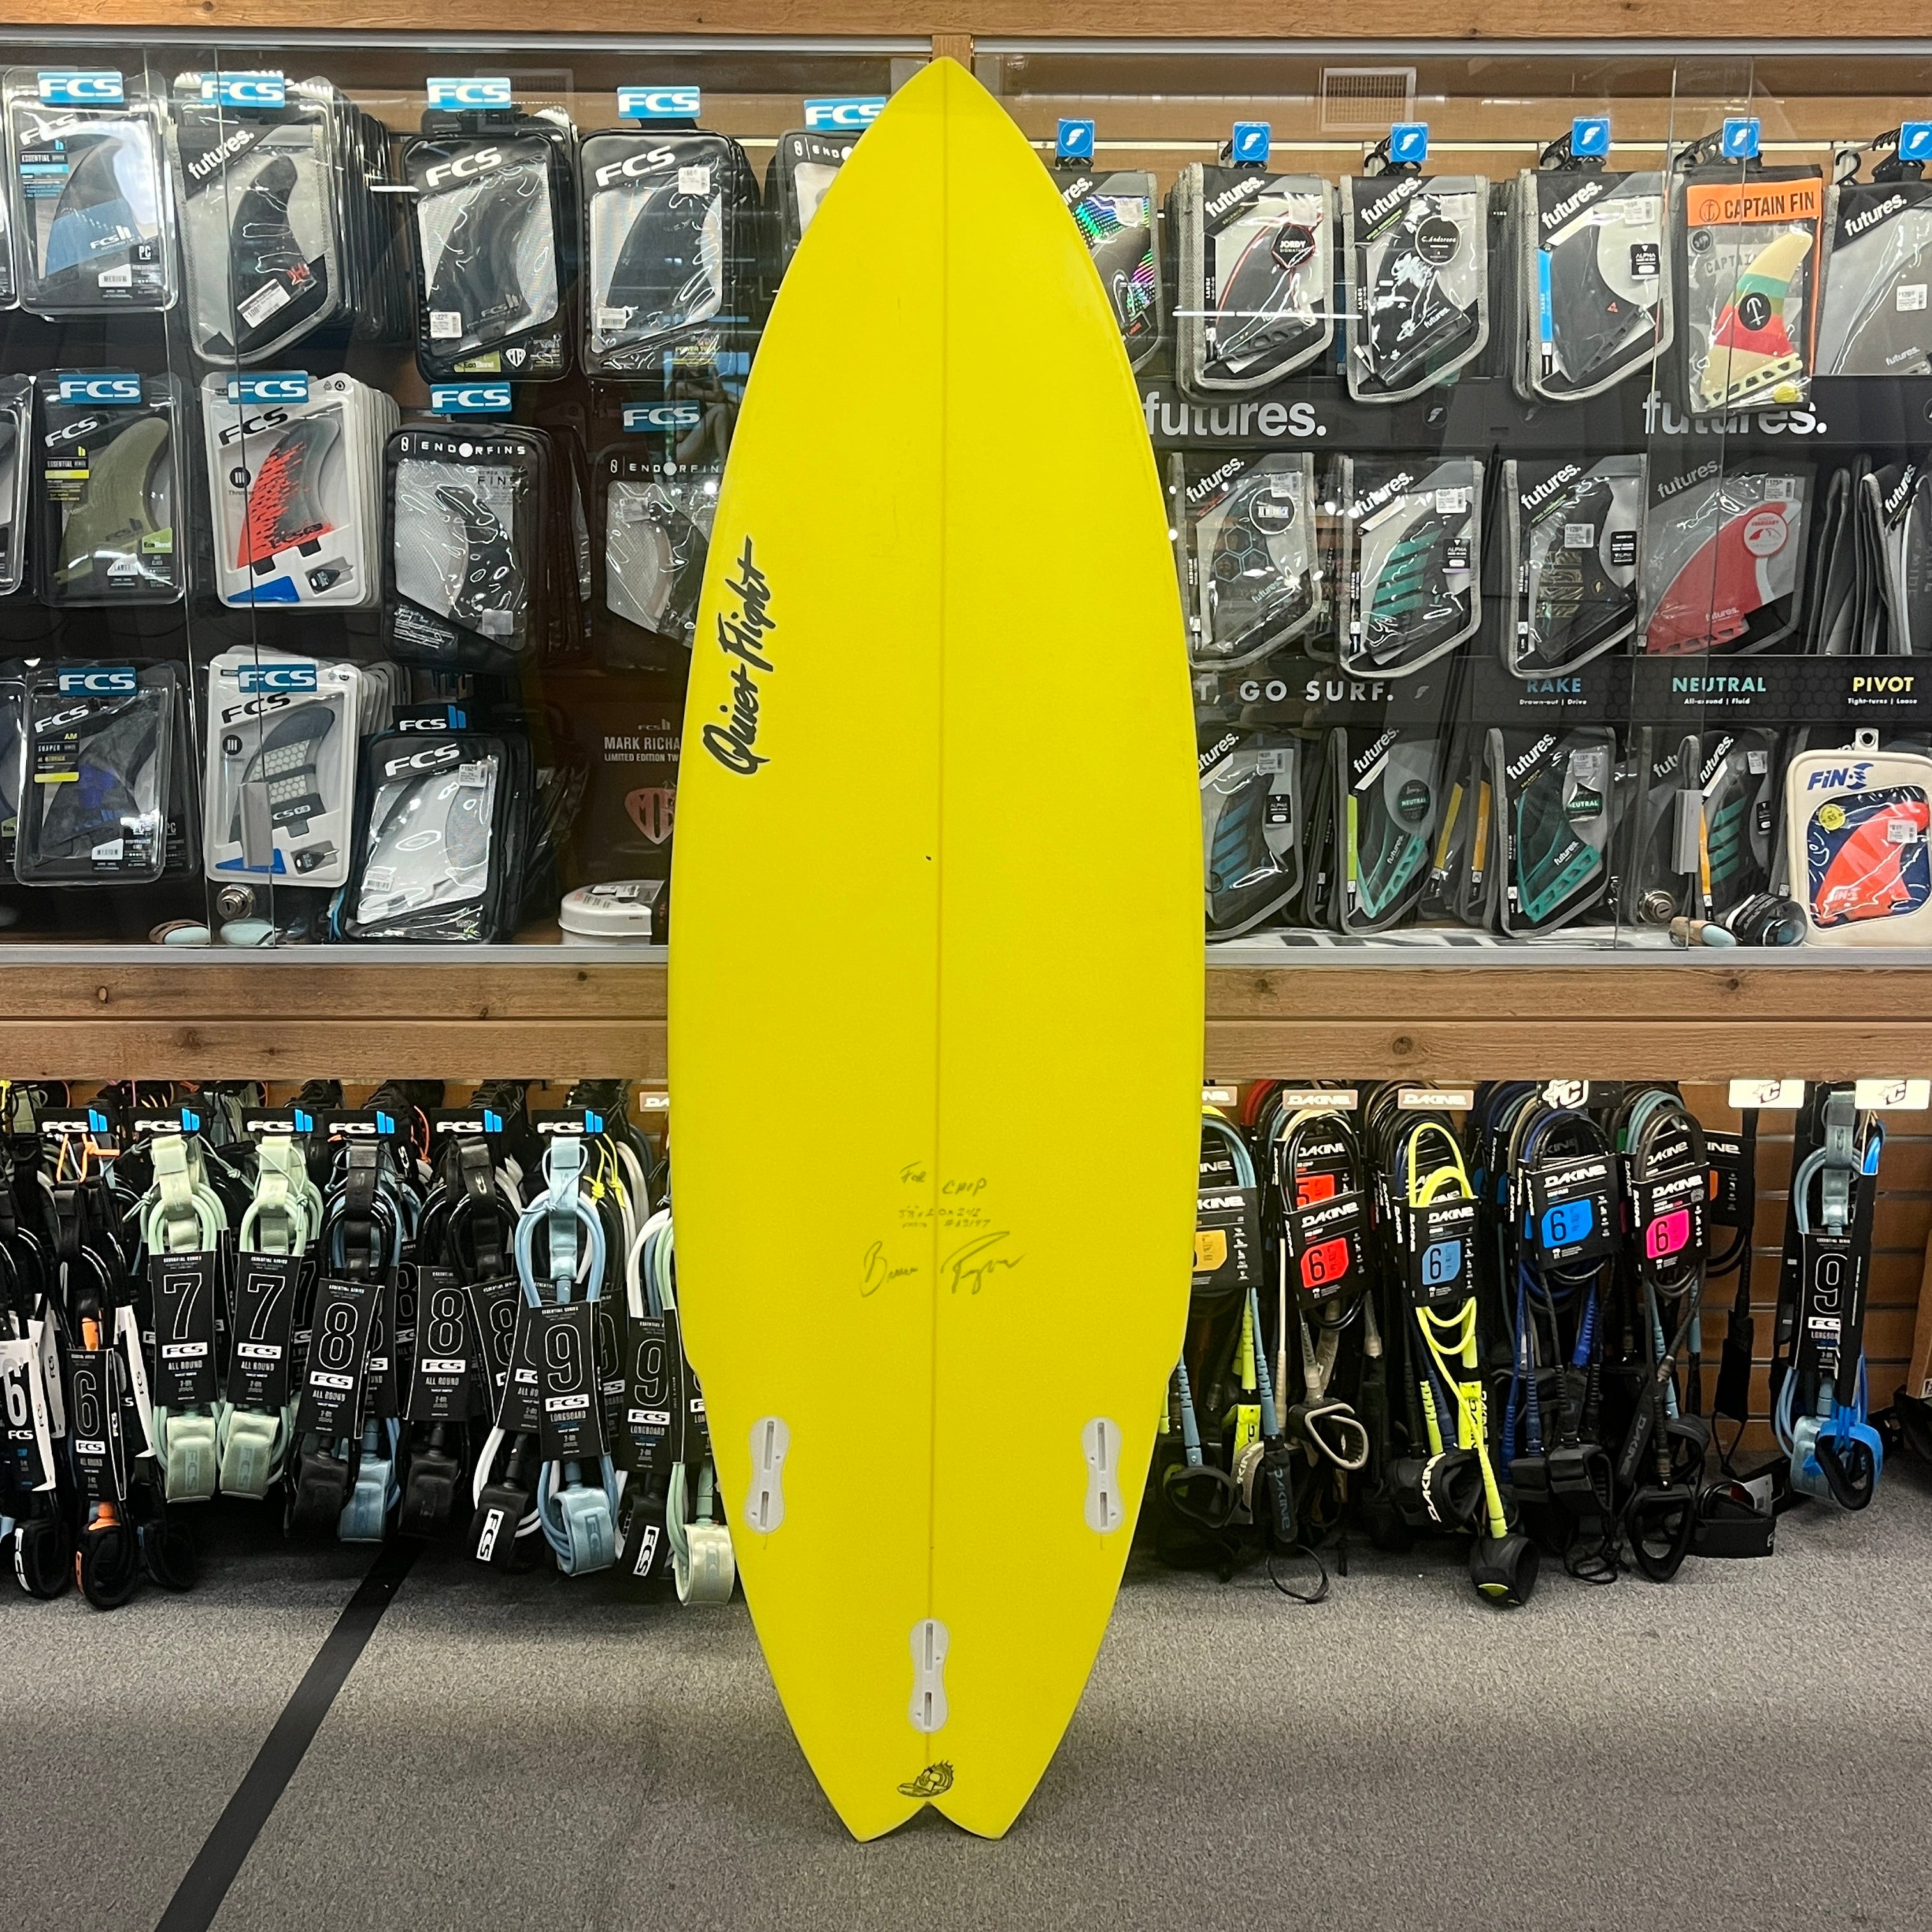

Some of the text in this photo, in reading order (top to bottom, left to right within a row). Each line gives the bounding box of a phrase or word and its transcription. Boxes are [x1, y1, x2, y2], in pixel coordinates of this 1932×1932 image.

[40, 79, 123, 98] FCS
[202, 80, 284, 102] FCS
[427, 84, 510, 103] FCS
[618, 93, 700, 112] FCS
[806, 104, 884, 125] FCS
[188, 130, 254, 180] futures.
[595, 146, 675, 187] FCS
[426, 147, 502, 187] FCS
[1206, 175, 1264, 217] futures.
[1361, 176, 1423, 225] futures.
[1542, 181, 1603, 229] futures.
[1725, 192, 1814, 219] CAPTAIN FIN
[1845, 194, 1907, 236] futures.
[138, 246, 151, 257] PC
[61, 381, 140, 398] FCS
[227, 380, 308, 398] FCS
[432, 388, 510, 408] FCS
[624, 407, 700, 426] FCS
[1142, 392, 1326, 436] futures.
[45, 416, 98, 448] FCS
[219, 407, 288, 446] FCS
[1186, 456, 1245, 503] futures.
[1521, 462, 1581, 510] futures.
[1657, 459, 1722, 498] futures.
[1355, 472, 1414, 516] futures.
[703, 535, 776, 774] Quiet Flight
[60, 673, 135, 691] FCS
[240, 671, 316, 687] FCS
[1527, 677, 1581, 693] RAKE
[1672, 677, 1766, 693] NEUTRAL
[1853, 677, 1914, 693] PIVOT
[1240, 681, 1287, 702] GO
[1306, 680, 1394, 702] SURF.
[34, 705, 89, 733] FCS
[222, 692, 290, 724] FCS
[399, 719, 447, 731] FCS
[604, 736, 680, 750] MARK RICHA
[1353, 726, 1399, 774] futures.
[385, 744, 459, 777] FCS
[604, 753, 679, 762] LIMITED EDITION TW
[1506, 733, 1556, 780] futures.
[1287, 1094, 1351, 1105] DAKINE
[1402, 1093, 1467, 1105] DAKINE
[42, 1121, 89, 1133] FCS
[135, 1120, 181, 1133] FCS
[247, 1121, 294, 1133] FCS
[329, 1122, 376, 1135] FCS
[436, 1121, 484, 1133] FCS
[537, 1121, 585, 1134] FCS
[1646, 1142, 1688, 1166] DAKINE
[1543, 1165, 1607, 1188] DAKINE
[1652, 1175, 1703, 1199] DAKINE
[1297, 1182, 1310, 1206] 5
[1301, 1202, 1359, 1229] DAKINE
[1427, 1206, 1474, 1223] DAKINE
[1550, 1209, 1566, 1241] 6
[1655, 1220, 1669, 1252] 6
[1309, 1249, 1326, 1282] 6
[1430, 1248, 1441, 1280] 6
[1813, 1253, 1848, 1314] 9
[164, 1273, 202, 1340] 7
[247, 1273, 286, 1340] 7
[428, 1288, 464, 1355] 8
[489, 1300, 517, 1366] 8
[319, 1302, 358, 1370] 8
[167, 1345, 203, 1355] FCS
[241, 1346, 277, 1356] FCS
[544, 1324, 583, 1392] 9
[168, 1360, 203, 1370] ALL ROUND
[241, 1361, 275, 1371] ALL ROUND
[425, 1361, 462, 1370] FCS
[634, 1338, 668, 1406] 9
[314, 1374, 349, 1386] FCS
[425, 1377, 459, 1385] ALL ROUND
[3, 1358, 27, 1426] 6
[73, 1370, 100, 1436] 6
[312, 1390, 325, 1400] ALL
[549, 1397, 586, 1408] FCS
[550, 1410, 586, 1423] LONGBOARD
[631, 1412, 668, 1422] FCS
[8, 1430, 33, 1439] FCS
[630, 1425, 665, 1436] LONGBOARD
[1273, 1469, 1291, 1531] DAKINE
[479, 1513, 500, 1558] FCS
[637, 1530, 657, 1574] FCS
